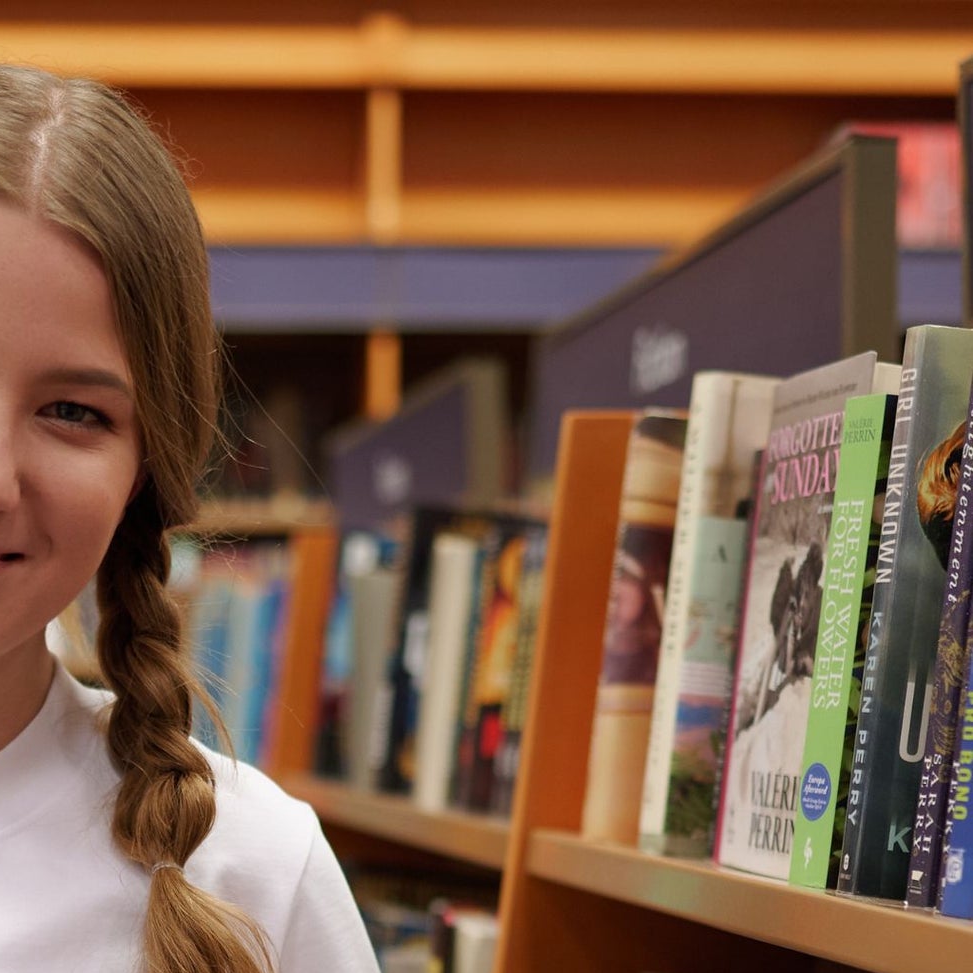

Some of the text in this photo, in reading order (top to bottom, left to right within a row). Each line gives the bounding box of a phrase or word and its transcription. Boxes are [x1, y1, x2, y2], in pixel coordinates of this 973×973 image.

[769, 411, 845, 462] FORGOTTE
[844, 429, 877, 443] PERRIN
[876, 368, 917, 583] GIRL UNKNOWN
[813, 501, 851, 709] FOR FLOWERS
[825, 500, 865, 710] FRESH WATER
[848, 611, 883, 826] KAREN PERRY
[750, 768, 801, 812] VALÉRI
[913, 756, 932, 850] PERRY
[922, 753, 942, 853] SARAH
[953, 750, 973, 820] BONO
